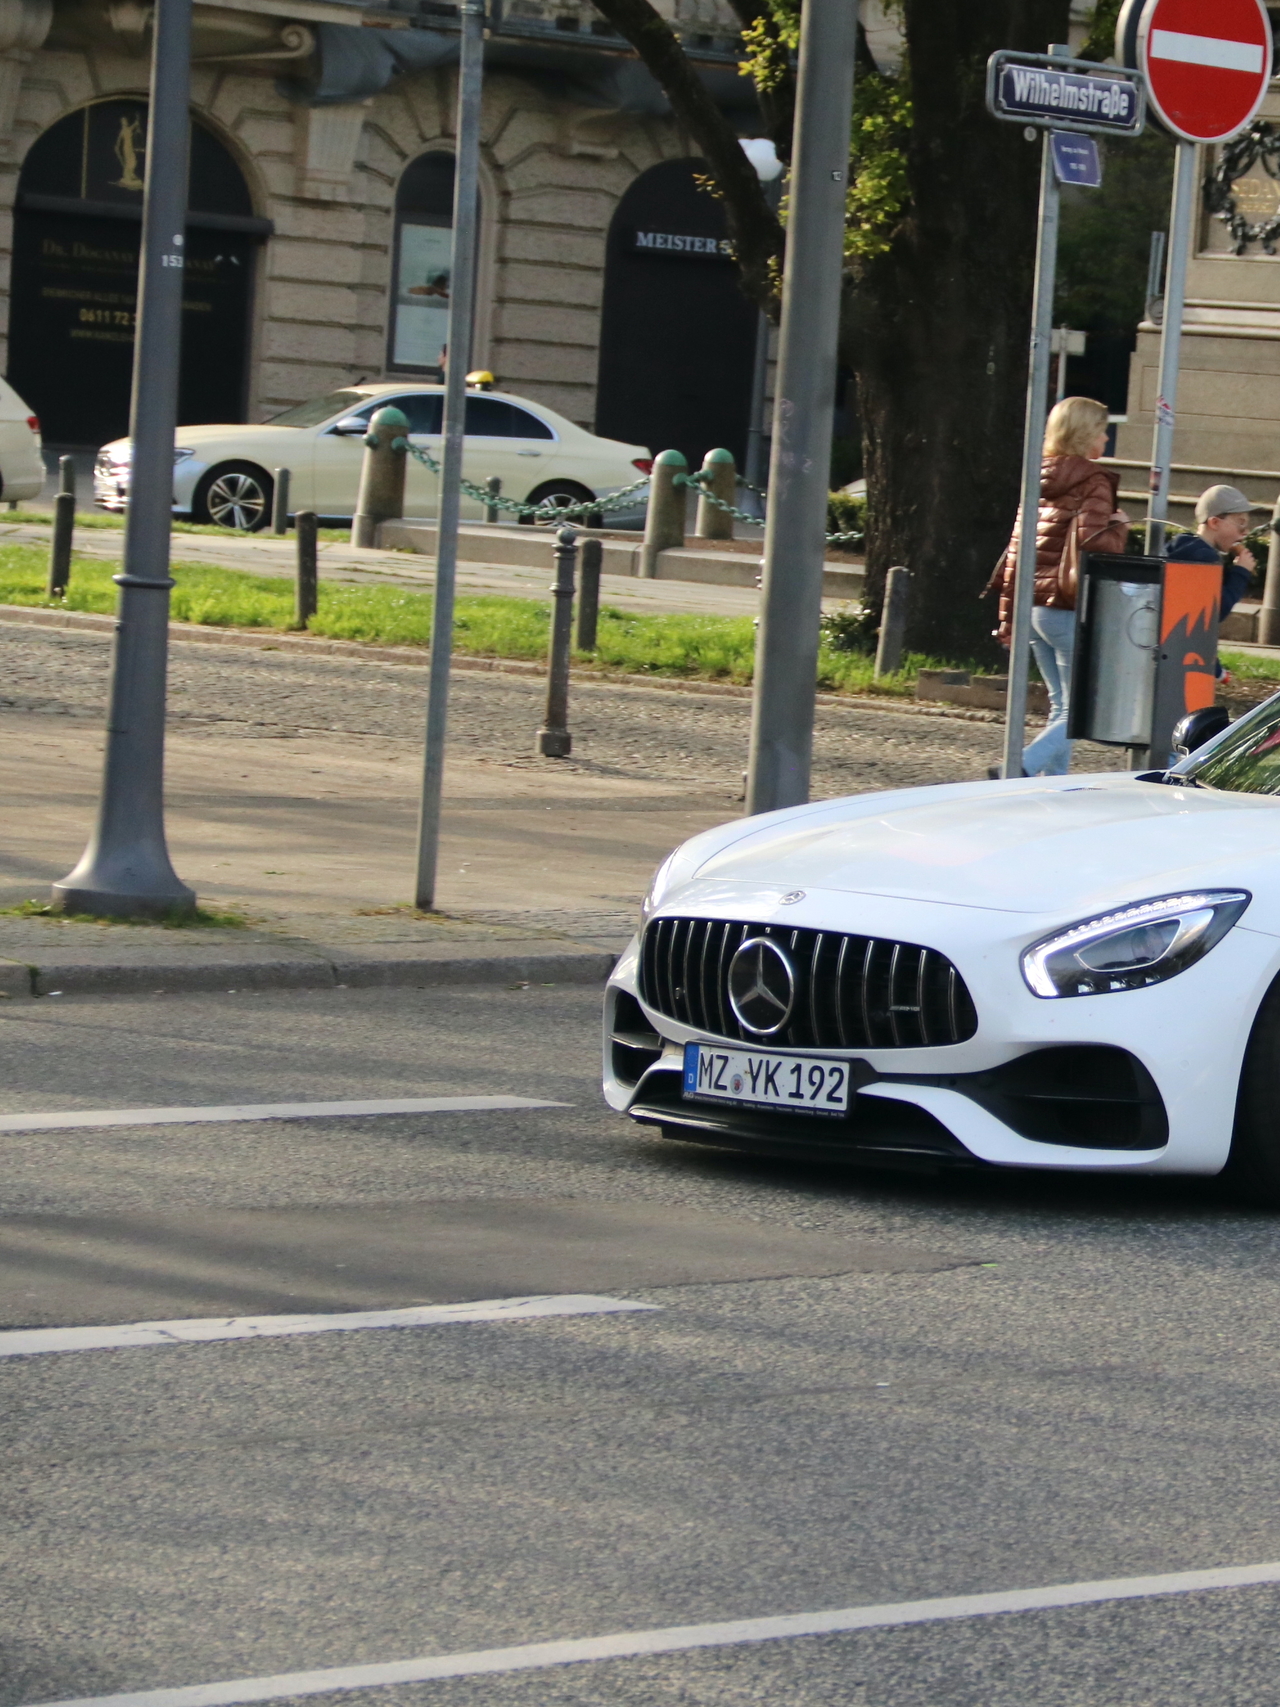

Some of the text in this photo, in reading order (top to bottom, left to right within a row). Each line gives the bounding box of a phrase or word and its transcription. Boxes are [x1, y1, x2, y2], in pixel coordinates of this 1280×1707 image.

[1012, 69, 1129, 118] Wilhelmstraße
[687, 1073, 695, 1084] D
[699, 1052, 845, 1104] MZ YK 192
